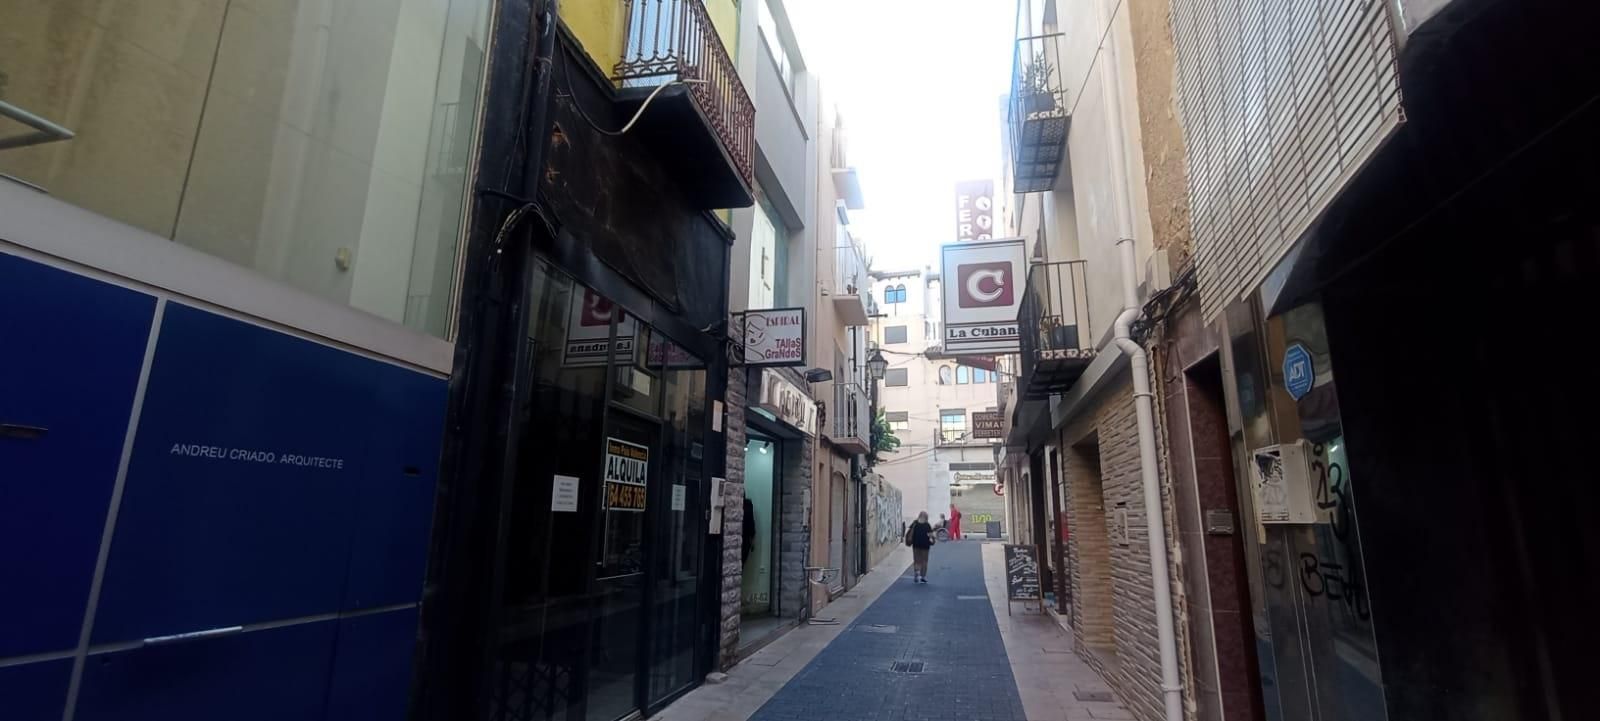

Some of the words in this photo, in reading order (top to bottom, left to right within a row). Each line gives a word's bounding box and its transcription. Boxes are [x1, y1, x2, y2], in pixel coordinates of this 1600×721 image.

[958, 194, 974, 241] FER
[950, 329, 966, 338] La
[971, 327, 1019, 337] Cuban
[1289, 361, 1305, 382] ADT
[170, 443, 228, 459] ANDREU
[279, 453, 344, 470] ARQUITECTE
[606, 455, 646, 485] ALQUILA
